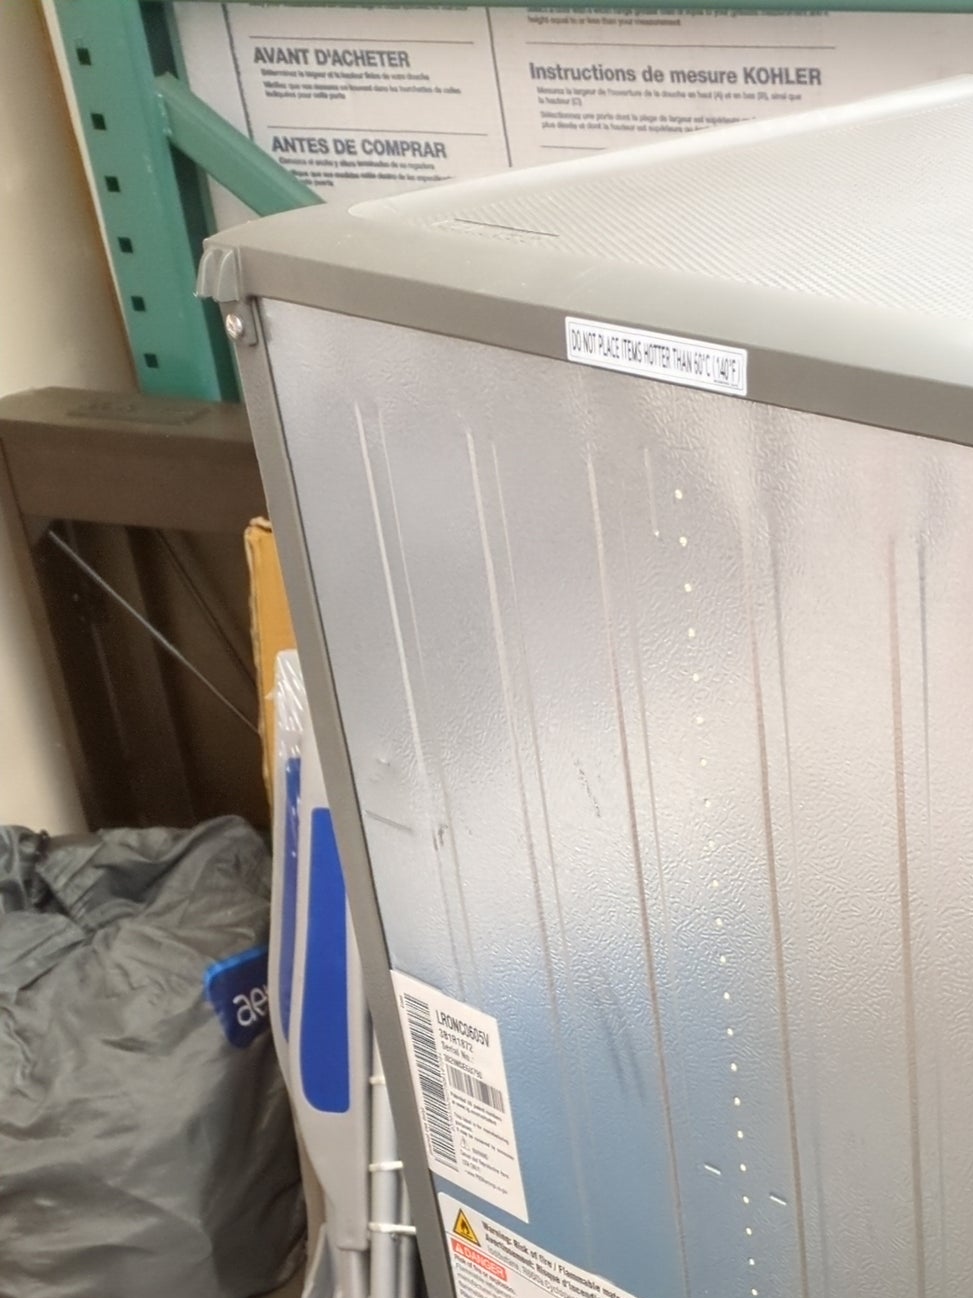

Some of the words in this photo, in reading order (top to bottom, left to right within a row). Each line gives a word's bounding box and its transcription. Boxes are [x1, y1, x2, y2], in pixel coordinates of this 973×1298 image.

[253, 47, 310, 65] AVANT
[316, 48, 411, 68] D'ACHETER
[529, 62, 637, 82] Instructions
[642, 65, 665, 83] de
[670, 68, 737, 84] mesure
[743, 67, 822, 86] KOHLER
[272, 135, 328, 154] ANTES
[333, 138, 357, 156] DE
[361, 139, 447, 158] COMPRAR
[571, 329, 581, 352] DO
[583, 332, 597, 354] NOT
[598, 334, 620, 359] PLACE
[621, 338, 642, 364] ITEMS
[644, 343, 670, 369] HOTTER
[672, 348, 692, 374] THAN
[233, 985, 268, 1026] ae
[463, 1247, 505, 1279] DANGER
